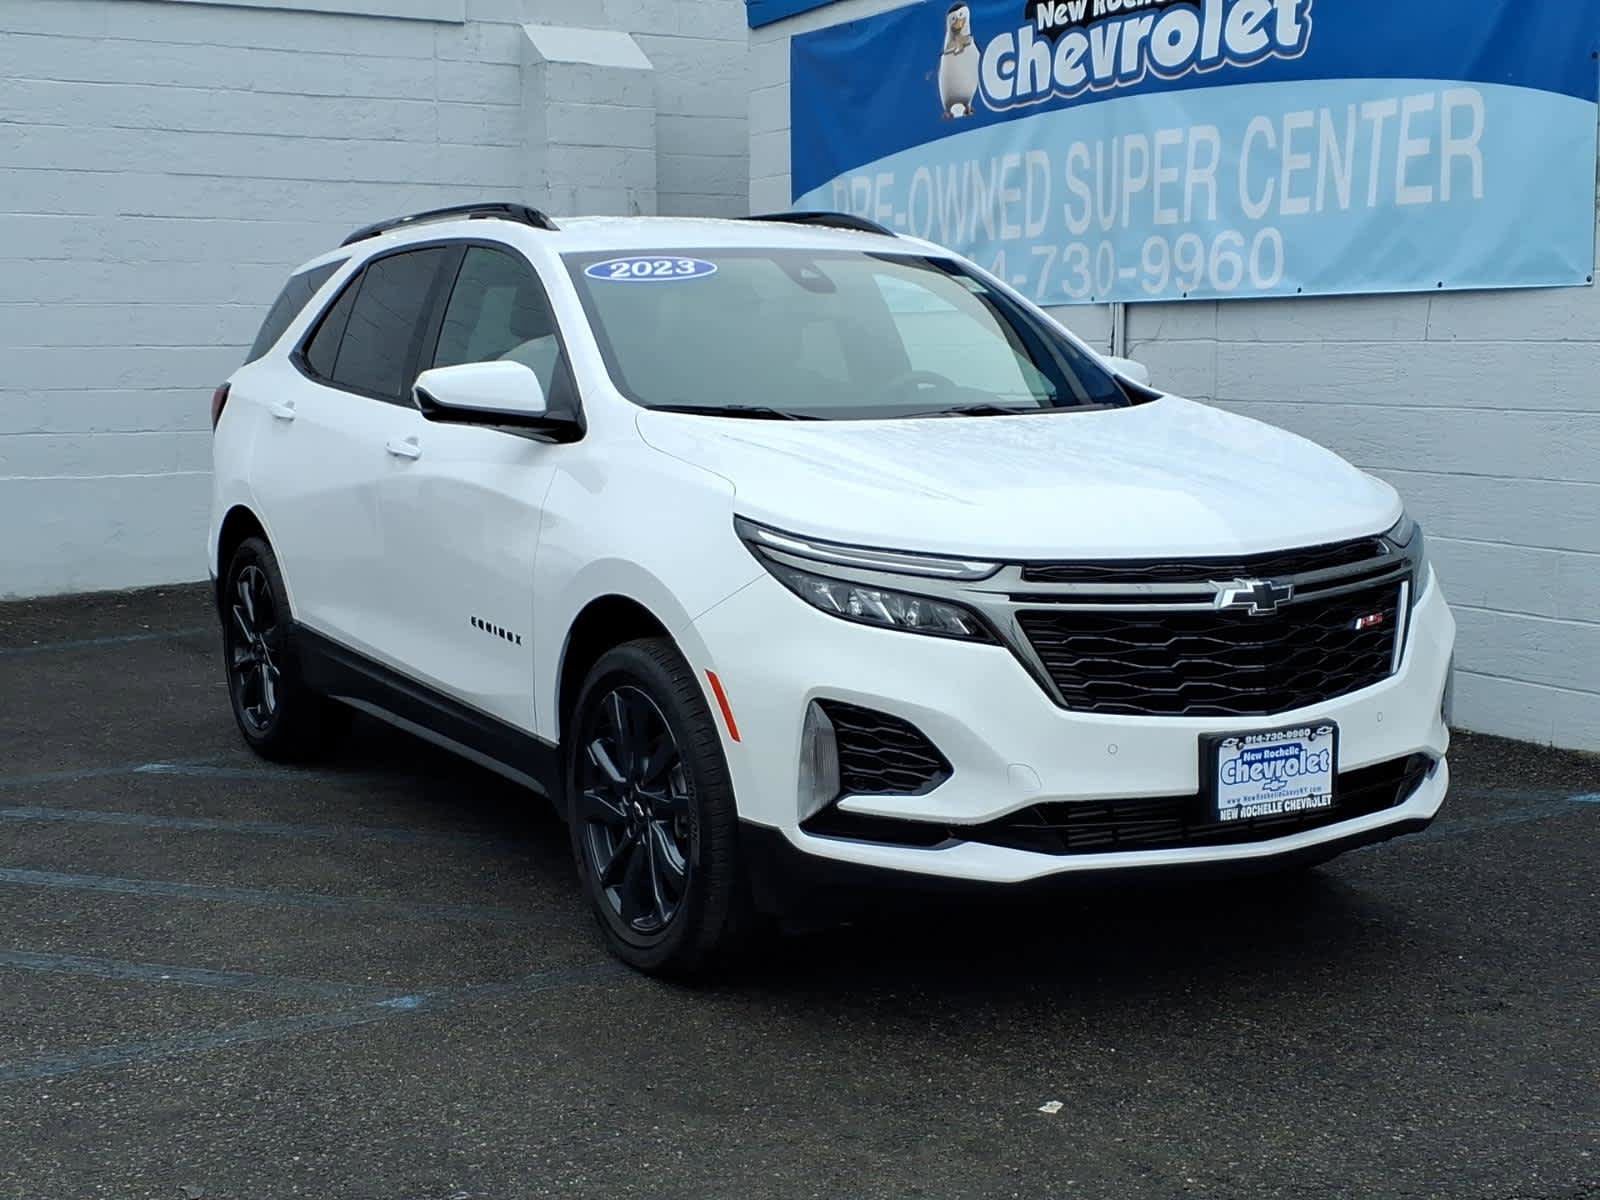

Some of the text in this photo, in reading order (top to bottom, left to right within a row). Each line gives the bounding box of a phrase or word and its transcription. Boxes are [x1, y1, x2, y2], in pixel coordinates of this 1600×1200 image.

[1036, 0, 1087, 30] New
[981, 0, 1304, 101] Chevrolet
[832, 86, 1486, 245] PRE-OWNED SUPER CENTER
[609, 259, 697, 279] 2023
[470, 615, 522, 647] EQUINOX
[1220, 748, 1330, 785] Chevrolet
[1243, 746, 1300, 762] New Rochelle
[1220, 794, 1332, 821] NEW ROCHELLE CHEVROLET
